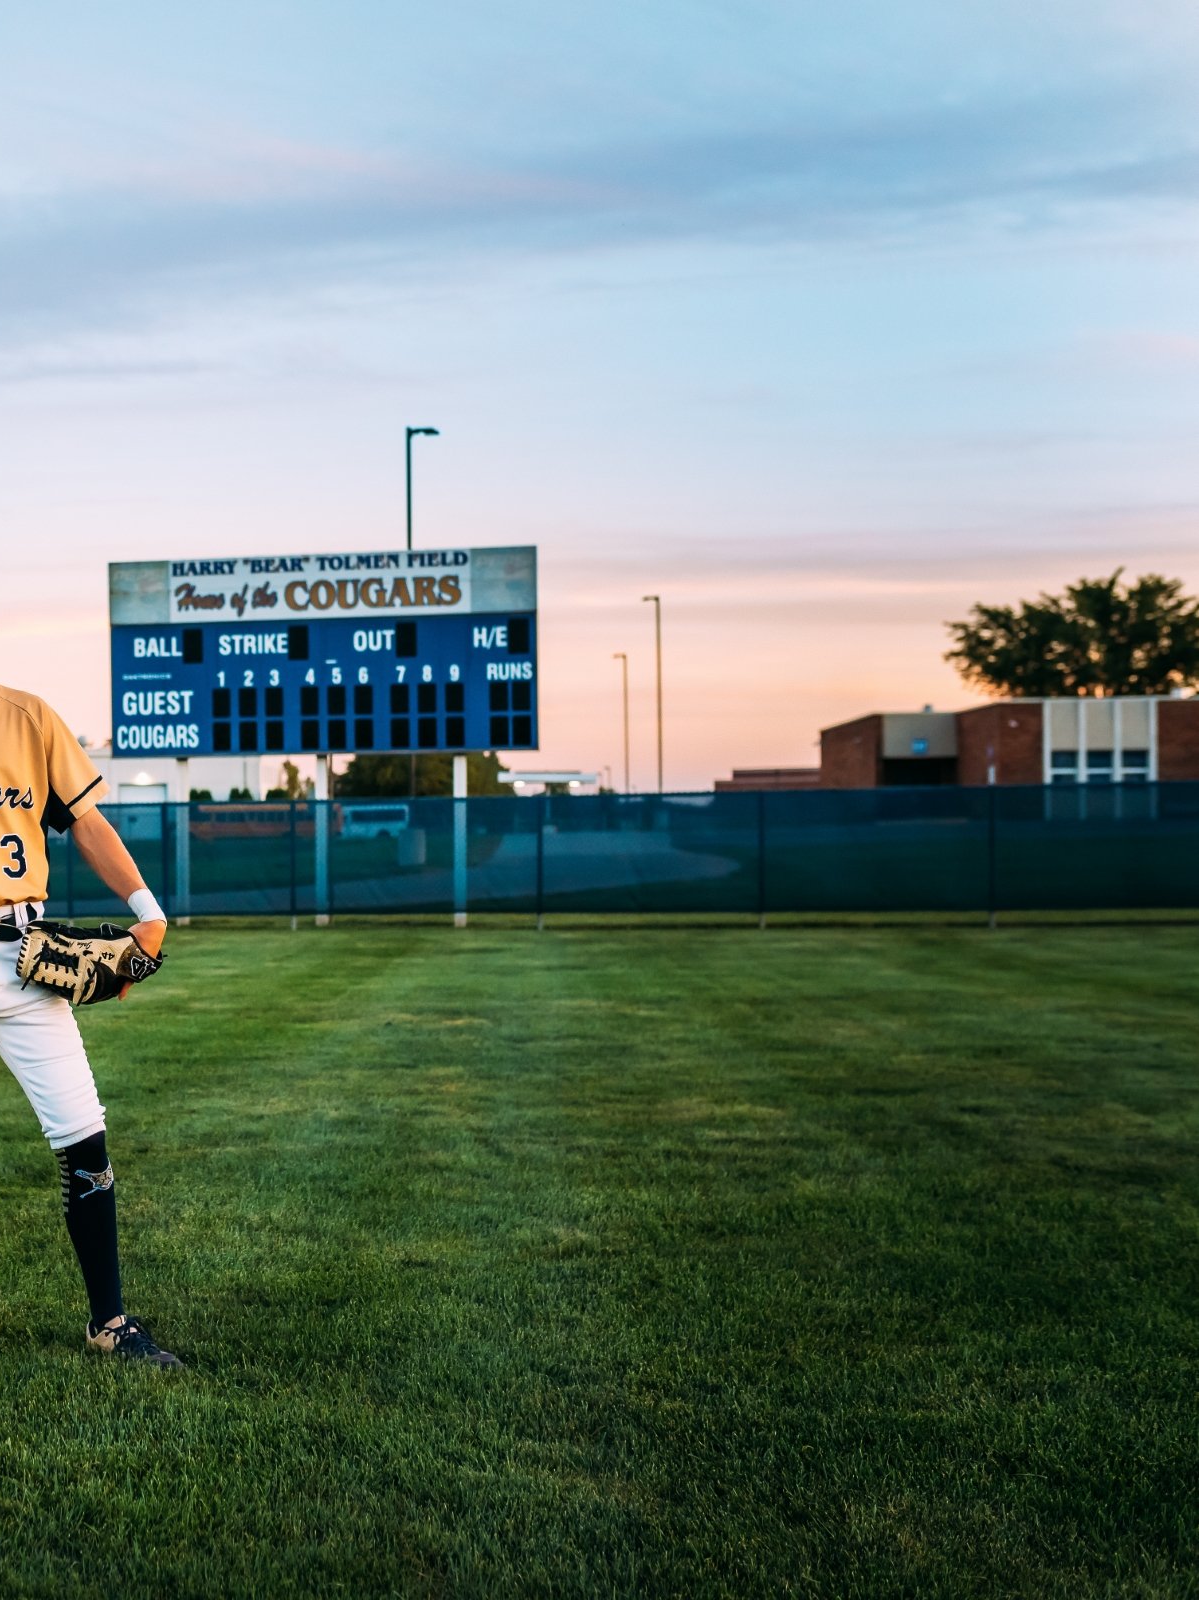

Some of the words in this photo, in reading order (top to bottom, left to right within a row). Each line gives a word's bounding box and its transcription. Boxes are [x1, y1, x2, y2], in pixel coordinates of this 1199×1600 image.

[172, 559, 238, 577] HARRY
[242, 555, 310, 574] "BEAR"
[316, 553, 400, 571] TOLMEN
[407, 551, 468, 569] FIELD
[175, 582, 225, 612] Home
[230, 583, 249, 617] of
[251, 581, 278, 610] the
[284, 574, 462, 612] COUGARS
[133, 636, 183, 658] BALL
[218, 633, 289, 656] STRIKE
[353, 629, 396, 652] OUT
[473, 625, 508, 649] H/E
[217, 670, 225, 688] 1
[243, 669, 254, 687] 2
[269, 669, 280, 687] 3
[304, 668, 315, 685] 4
[331, 667, 342, 685] 5
[358, 666, 369, 684] 6
[395, 665, 406, 683] 7
[422, 664, 433, 682] 8
[449, 664, 460, 682] 9
[486, 661, 533, 681] RUNS
[122, 690, 194, 716] GUEST
[116, 724, 199, 750] COUGARS
[0, 833, 28, 880] 3
